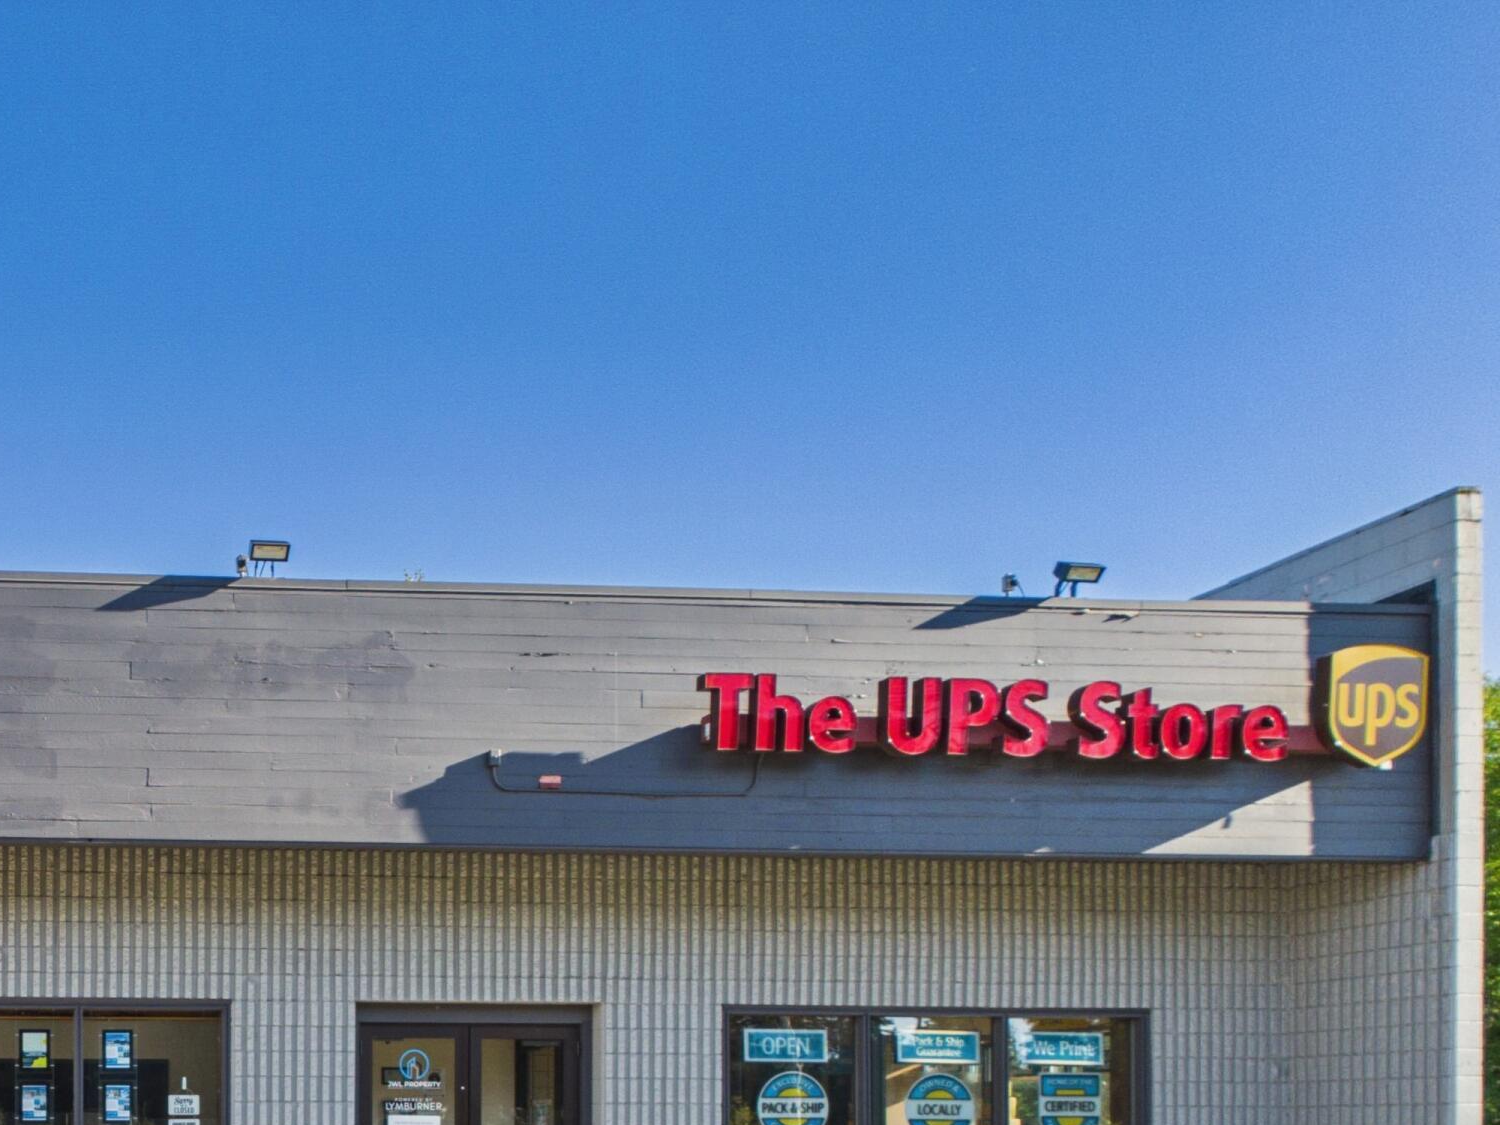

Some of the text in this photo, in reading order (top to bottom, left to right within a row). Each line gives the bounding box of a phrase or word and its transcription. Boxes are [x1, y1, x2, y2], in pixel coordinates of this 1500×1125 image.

[703, 672, 1290, 761] The UPS Store
[1338, 682, 1421, 746] ups
[761, 1036, 811, 1057] OPEN
[946, 1036, 965, 1050] Ship
[1033, 1040, 1056, 1056] We
[385, 1102, 443, 1111] LYMBURNER
[761, 1102, 825, 1113] PACK & SHIP
[917, 1104, 962, 1115] LOCALLY
[1045, 1101, 1096, 1112] CERTIFIED
